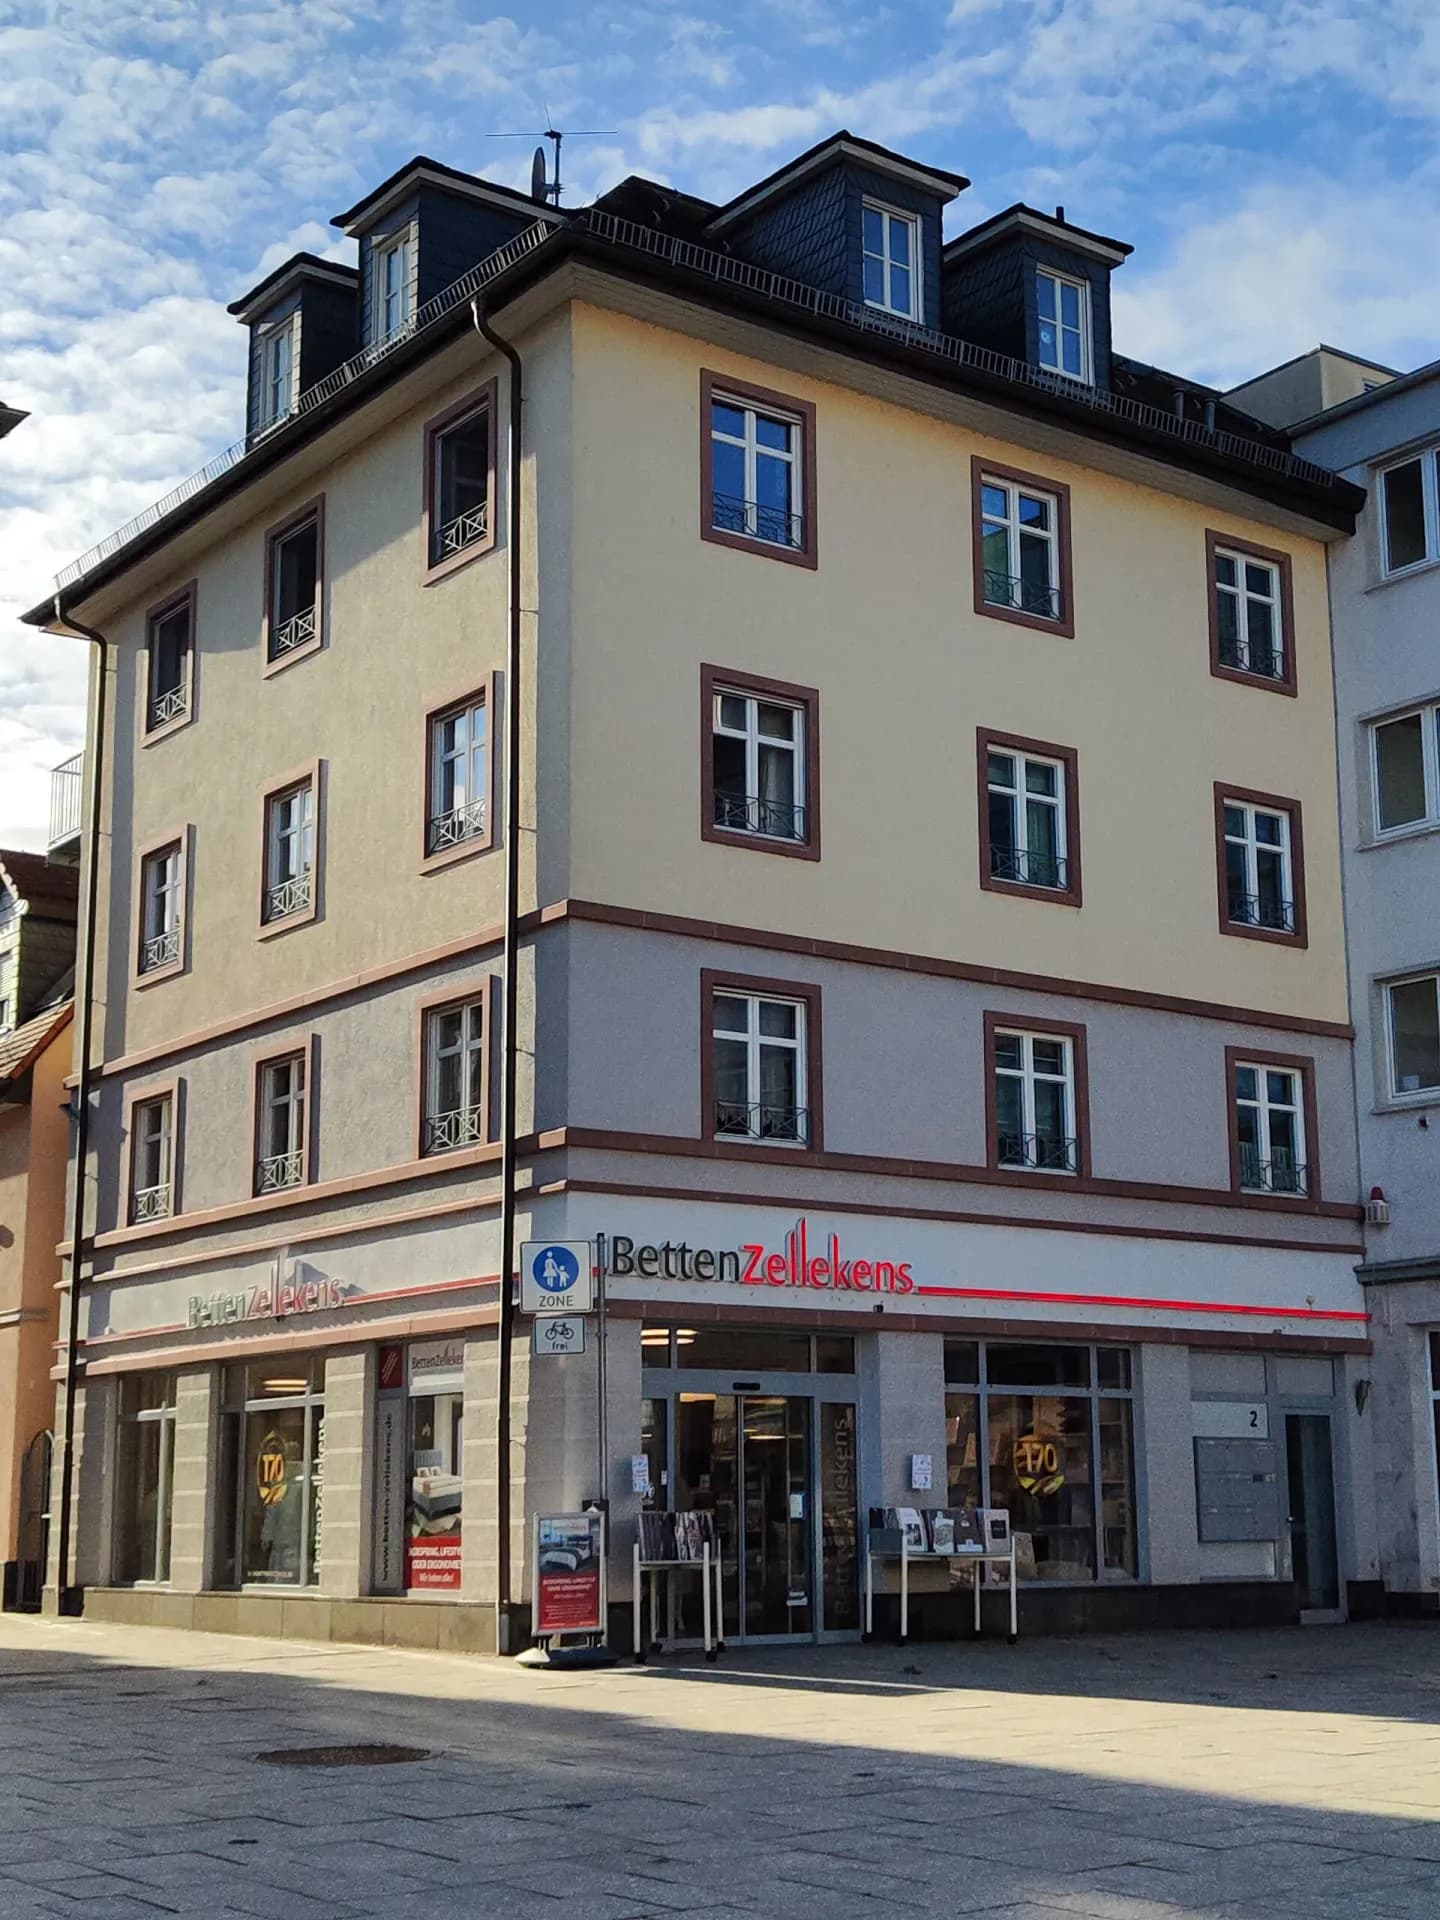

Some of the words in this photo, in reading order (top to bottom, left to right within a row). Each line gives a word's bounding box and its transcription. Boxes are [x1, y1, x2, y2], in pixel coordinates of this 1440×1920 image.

[610, 1216, 914, 1294] BettenZellekens
[186, 1251, 343, 1328] BettenZellekens
[539, 1295, 574, 1307] ZONE
[552, 1341, 568, 1351] frei
[1249, 1410, 1258, 1428] 2
